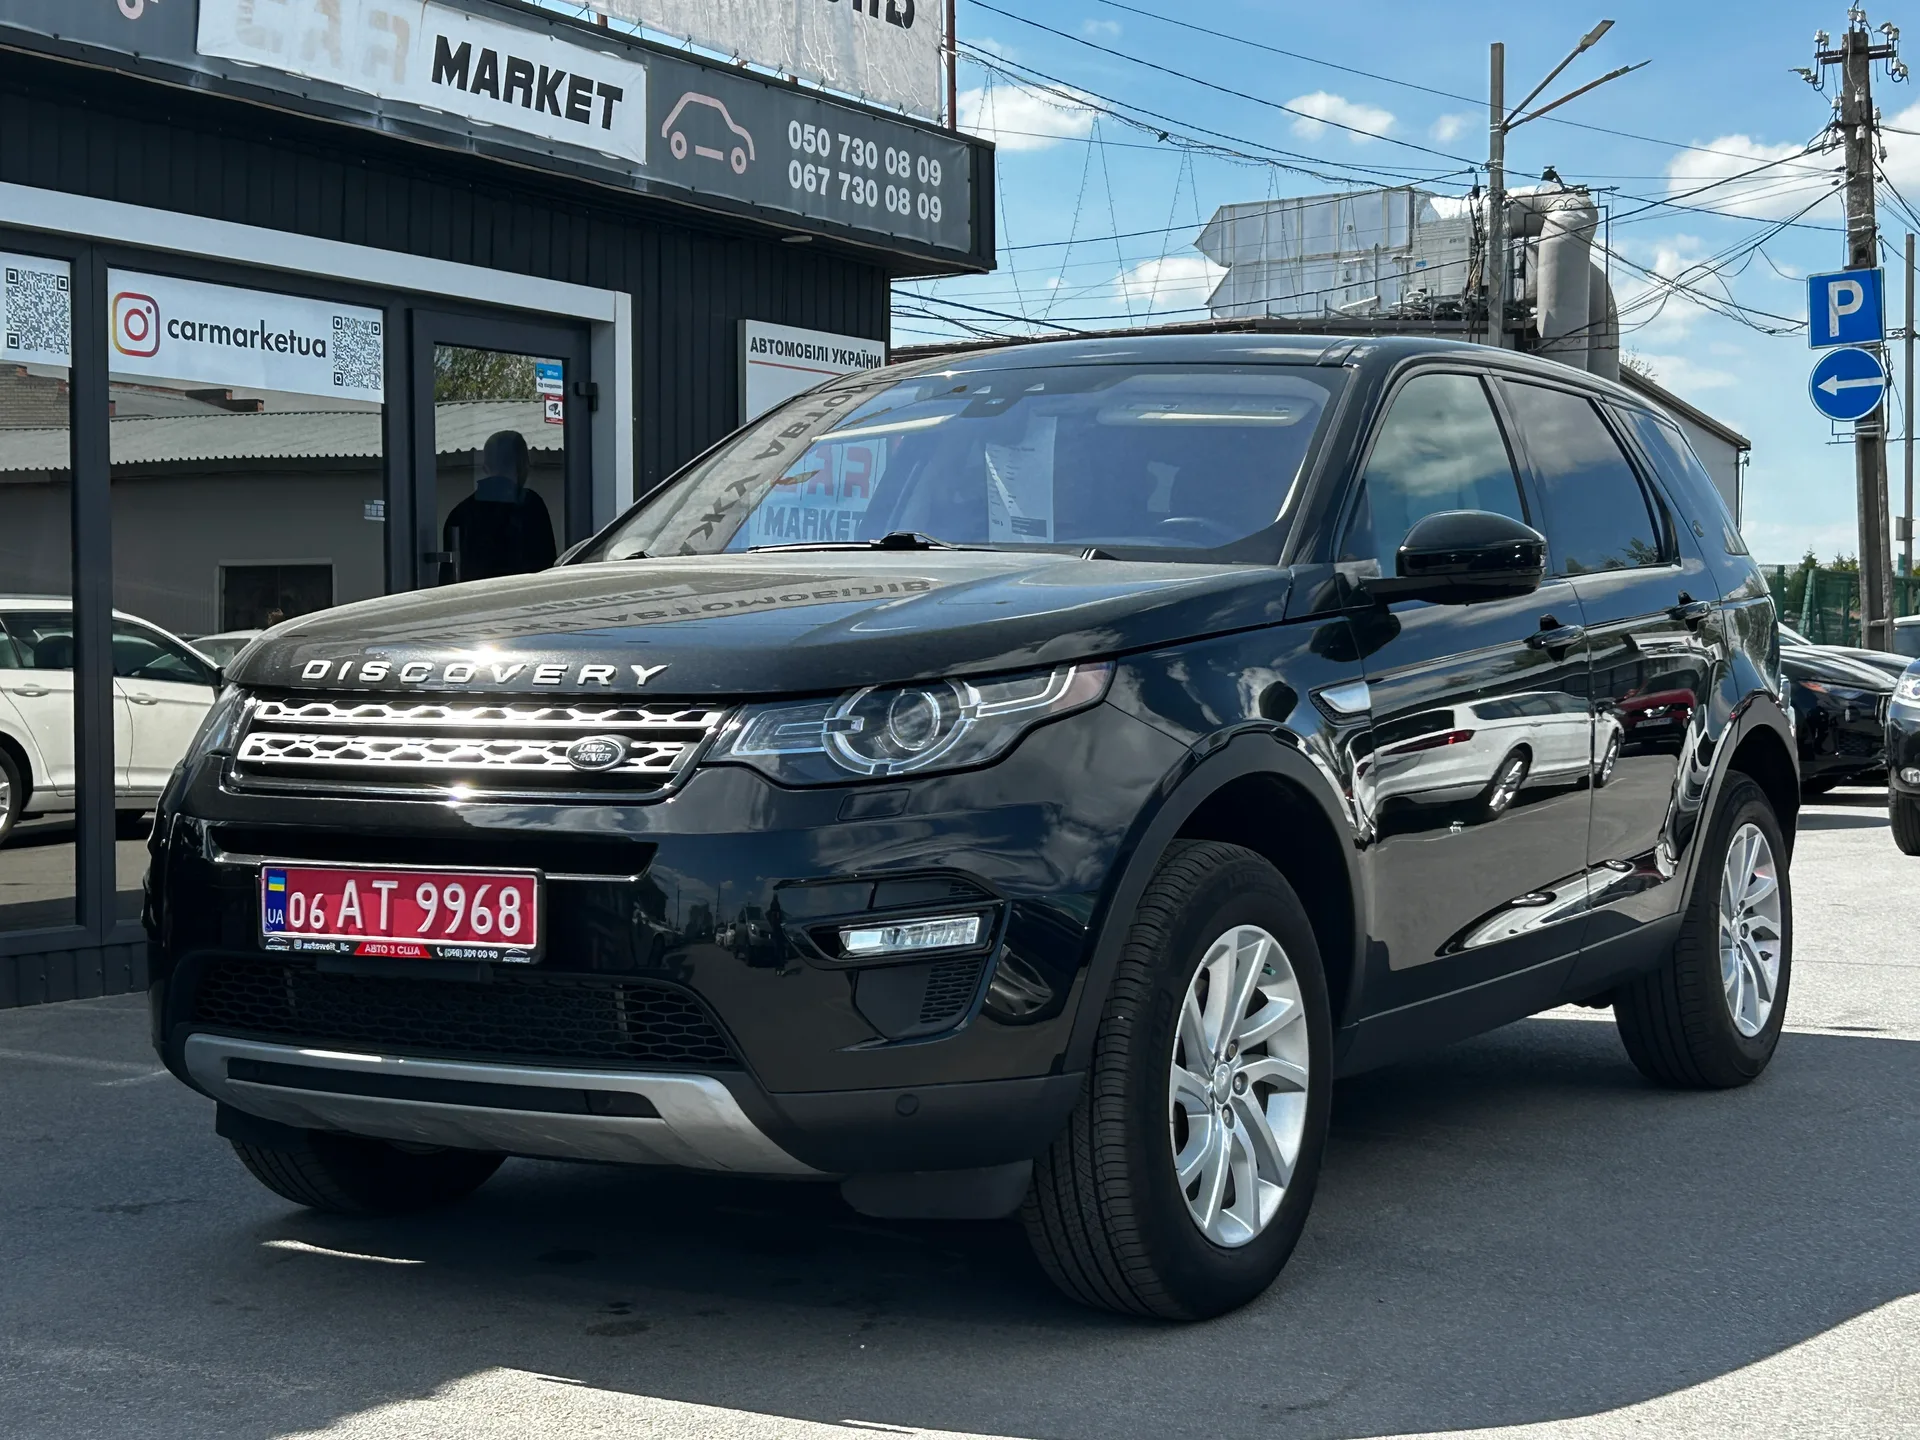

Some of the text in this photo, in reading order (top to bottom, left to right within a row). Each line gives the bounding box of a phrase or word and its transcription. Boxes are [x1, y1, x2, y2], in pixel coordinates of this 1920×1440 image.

[431, 34, 624, 131] MARKET
[788, 120, 942, 187] 050 730 08 09
[788, 160, 942, 223] 067 730 08 09
[1828, 280, 1863, 337] P
[167, 319, 327, 358] carmarketua
[750, 336, 882, 370] АВТОМОБІЛІ УКРАЇНИ
[301, 659, 671, 686] DISCOVERY
[579, 753, 611, 762] ROVER
[268, 909, 284, 925] UA
[289, 880, 521, 937] 06 AT 9968
[365, 944, 388, 953] АВТО
[398, 946, 421, 955] США
